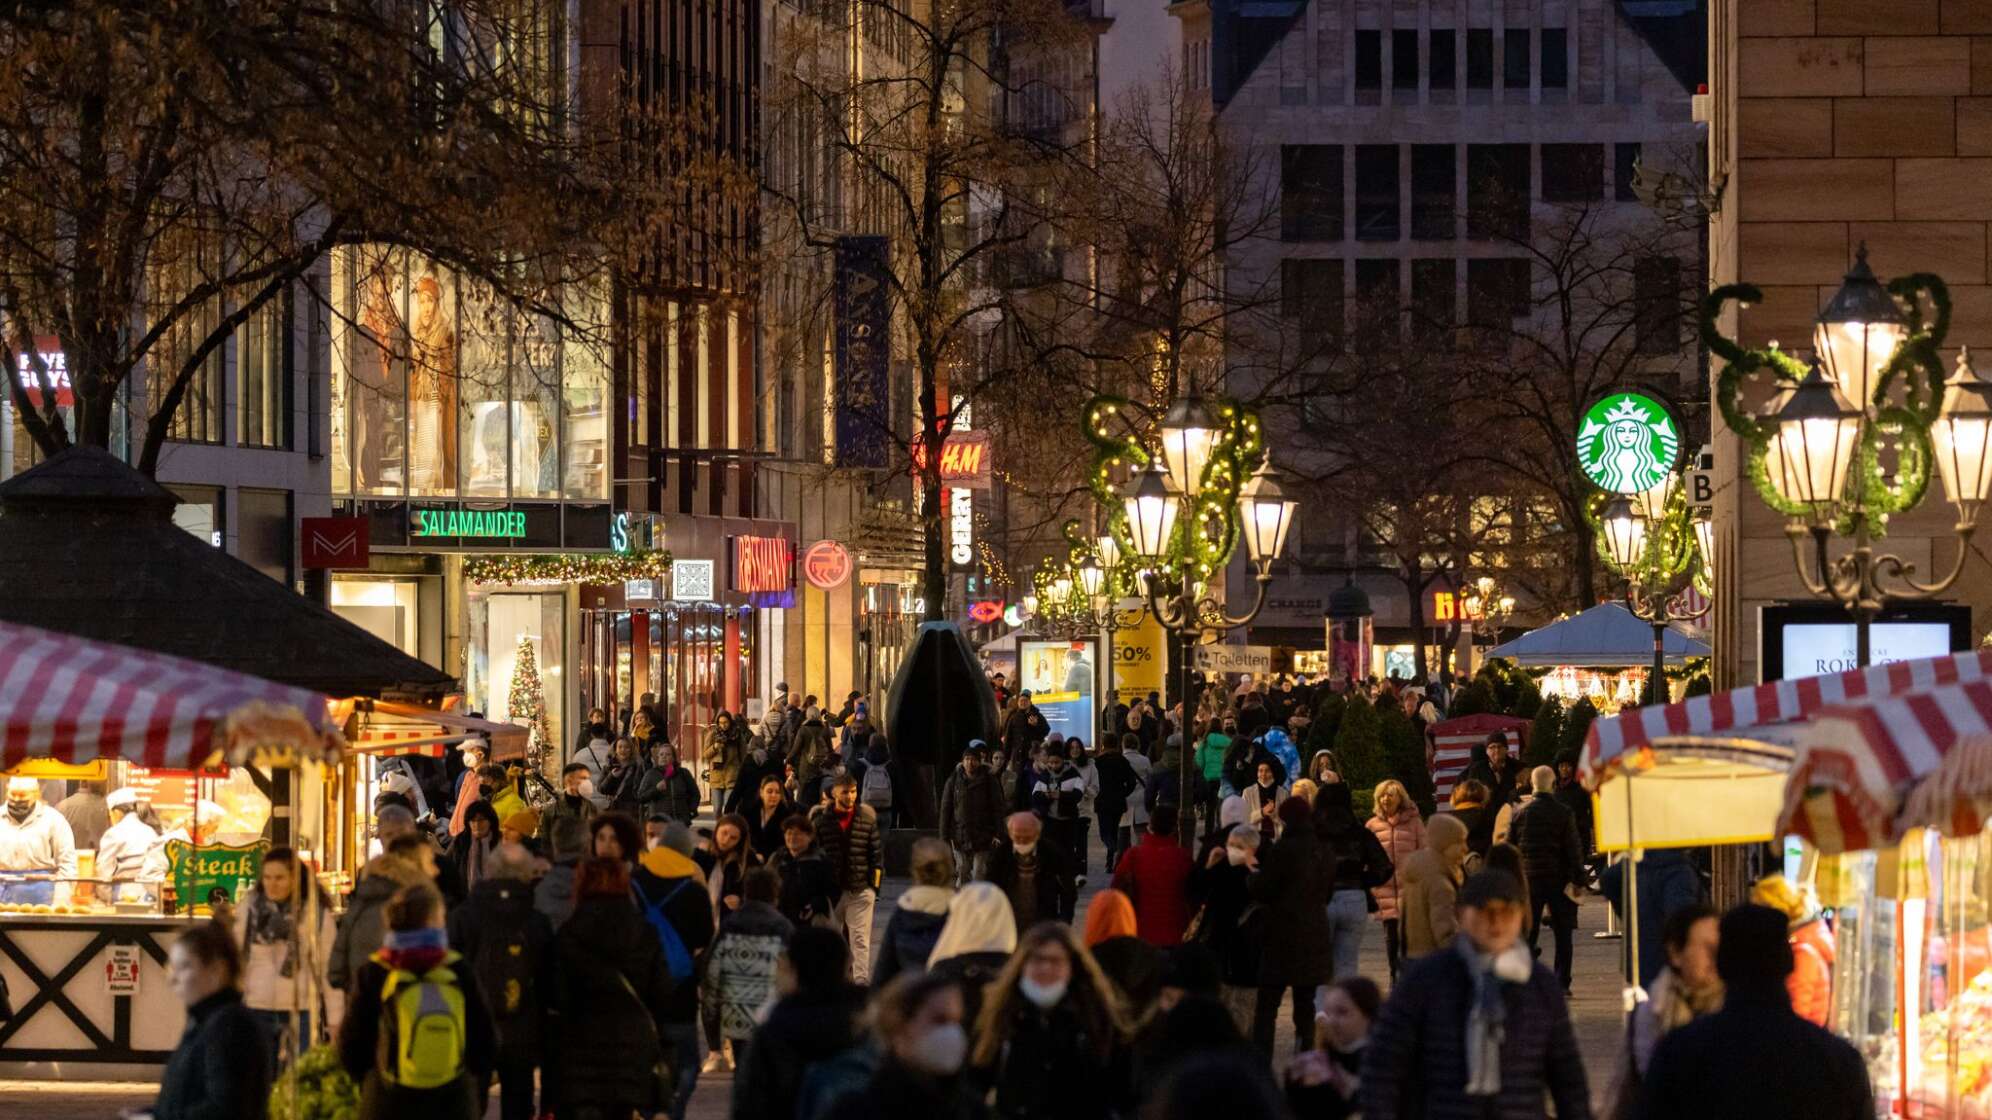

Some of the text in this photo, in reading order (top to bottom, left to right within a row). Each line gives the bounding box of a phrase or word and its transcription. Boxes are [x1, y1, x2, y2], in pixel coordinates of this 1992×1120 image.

[20, 353, 66, 370] FVE
[940, 444, 982, 474] H&M
[420, 511, 526, 537] SALAMANDER
[738, 535, 786, 593] ROSSMANN
[1212, 651, 1270, 667] Toiletten
[183, 855, 254, 876] Steak
